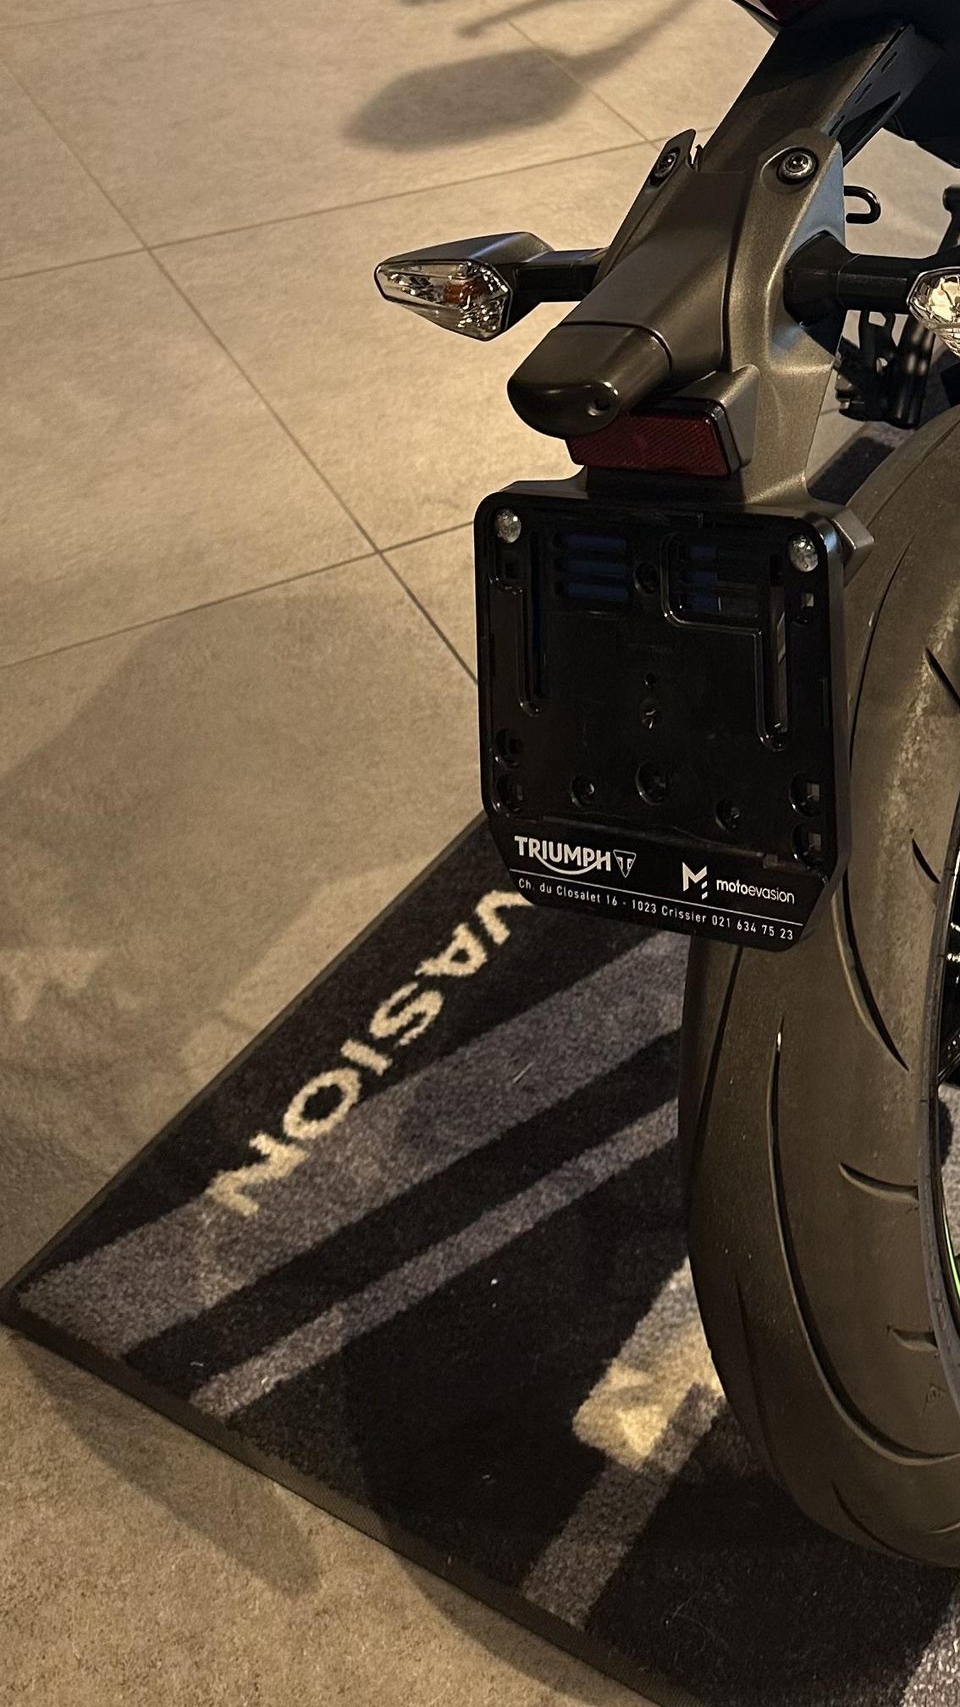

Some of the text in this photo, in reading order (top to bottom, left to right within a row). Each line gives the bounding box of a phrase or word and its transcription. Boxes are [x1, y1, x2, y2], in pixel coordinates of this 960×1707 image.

[514, 835, 612, 876] TRIUMPH
[540, 882, 552, 894] du
[556, 885, 601, 904] Closalet
[606, 894, 618, 907] 16
[631, 898, 657, 915] 1023
[711, 914, 731, 928] 021
[736, 919, 757, 934] 634
[761, 924, 775, 938] 75
[779, 928, 793, 941] 23
[716, 879, 795, 905] motoevasion
[200, 889, 536, 1217] VASION
